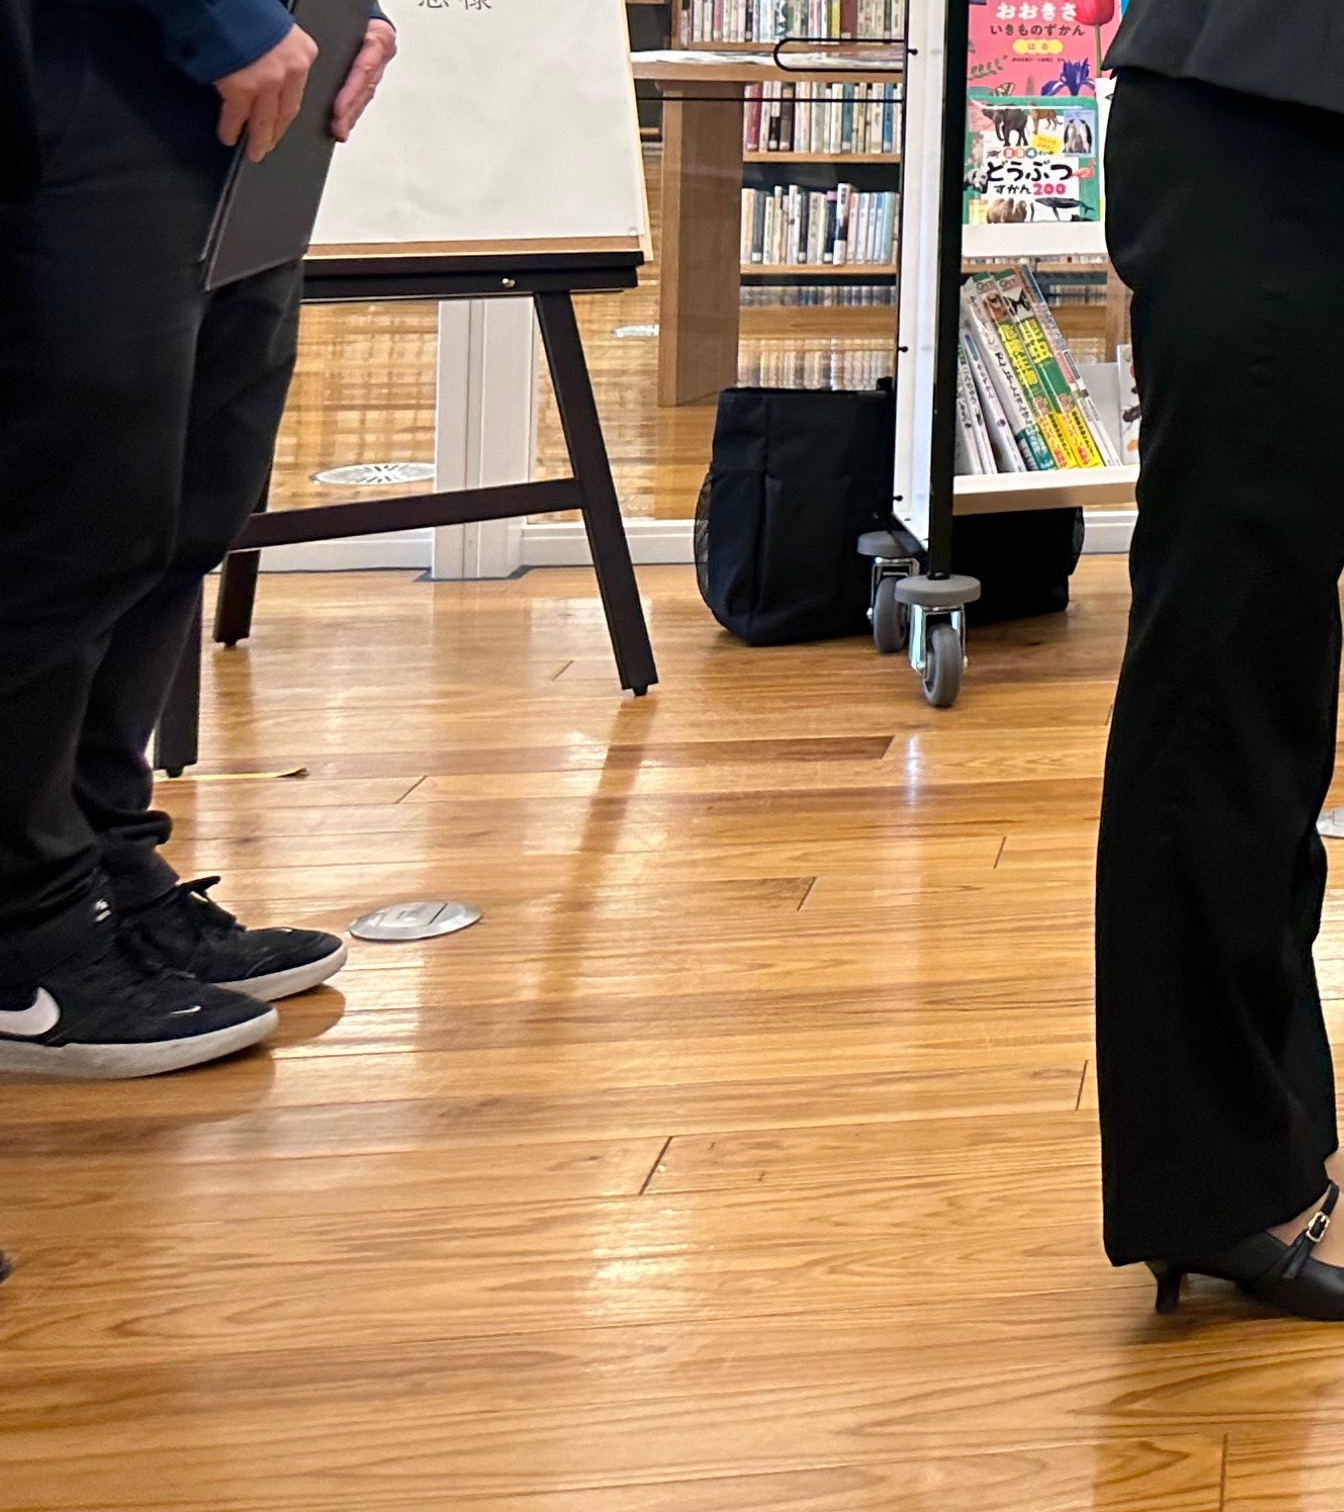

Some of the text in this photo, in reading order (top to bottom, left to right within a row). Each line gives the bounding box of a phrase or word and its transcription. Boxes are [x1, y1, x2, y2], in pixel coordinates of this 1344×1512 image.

[996, 2, 1077, 22] おおきさ
[990, 24, 1085, 36] いきものずかん
[987, 159, 1073, 182] どうぶつ
